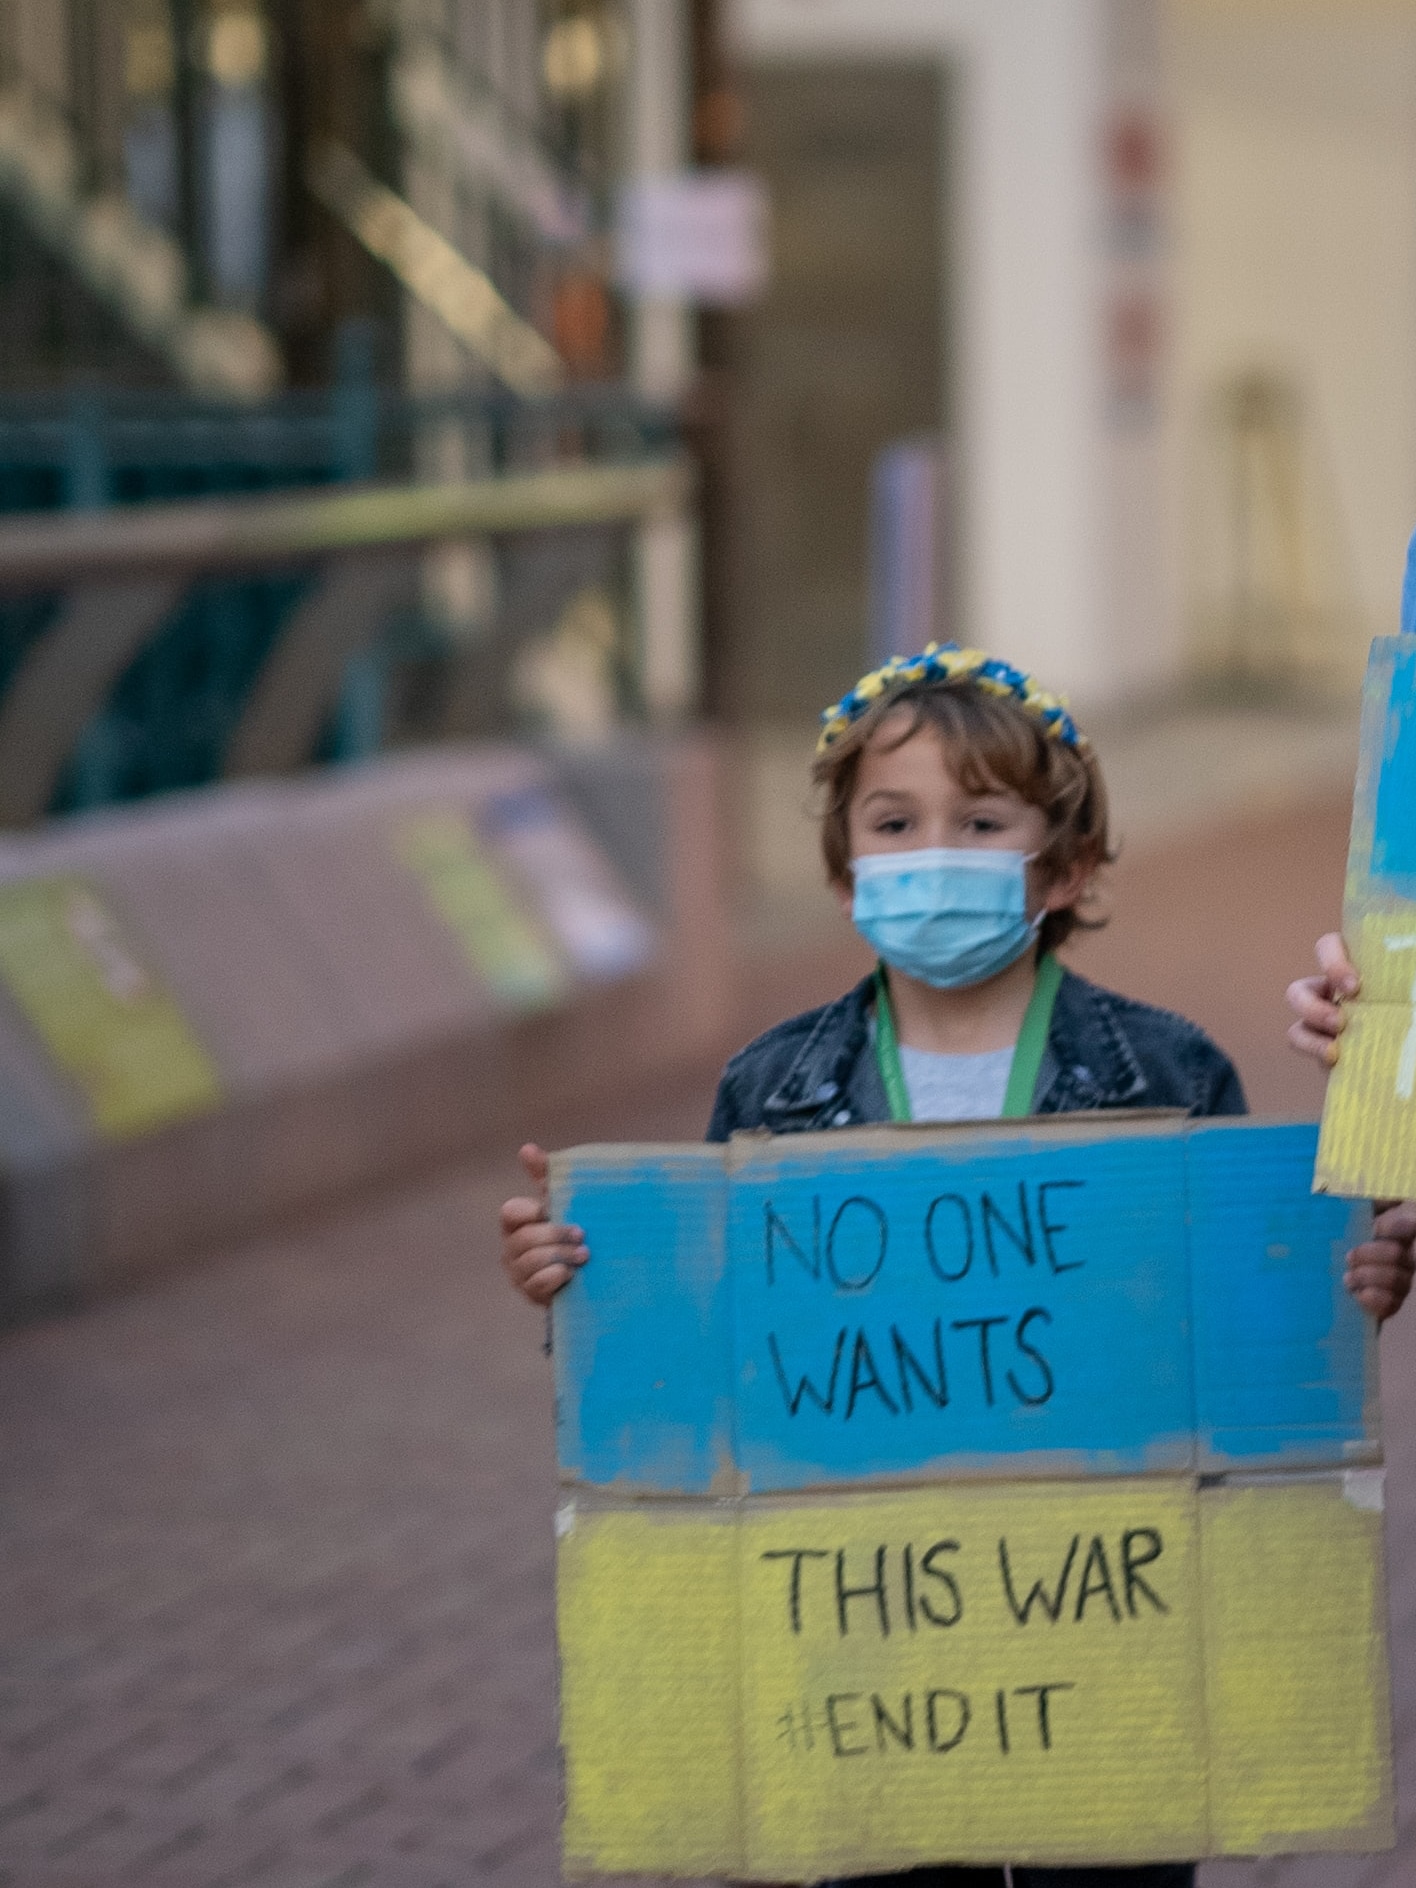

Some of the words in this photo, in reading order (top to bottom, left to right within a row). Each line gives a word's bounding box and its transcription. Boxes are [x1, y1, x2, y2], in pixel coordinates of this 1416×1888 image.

[762, 1196, 888, 1290] NO
[924, 1180, 1086, 1282] ONE
[768, 1307, 1056, 1420] WANTS
[761, 1540, 963, 1637] THIS
[999, 1527, 1169, 1627] WAR
